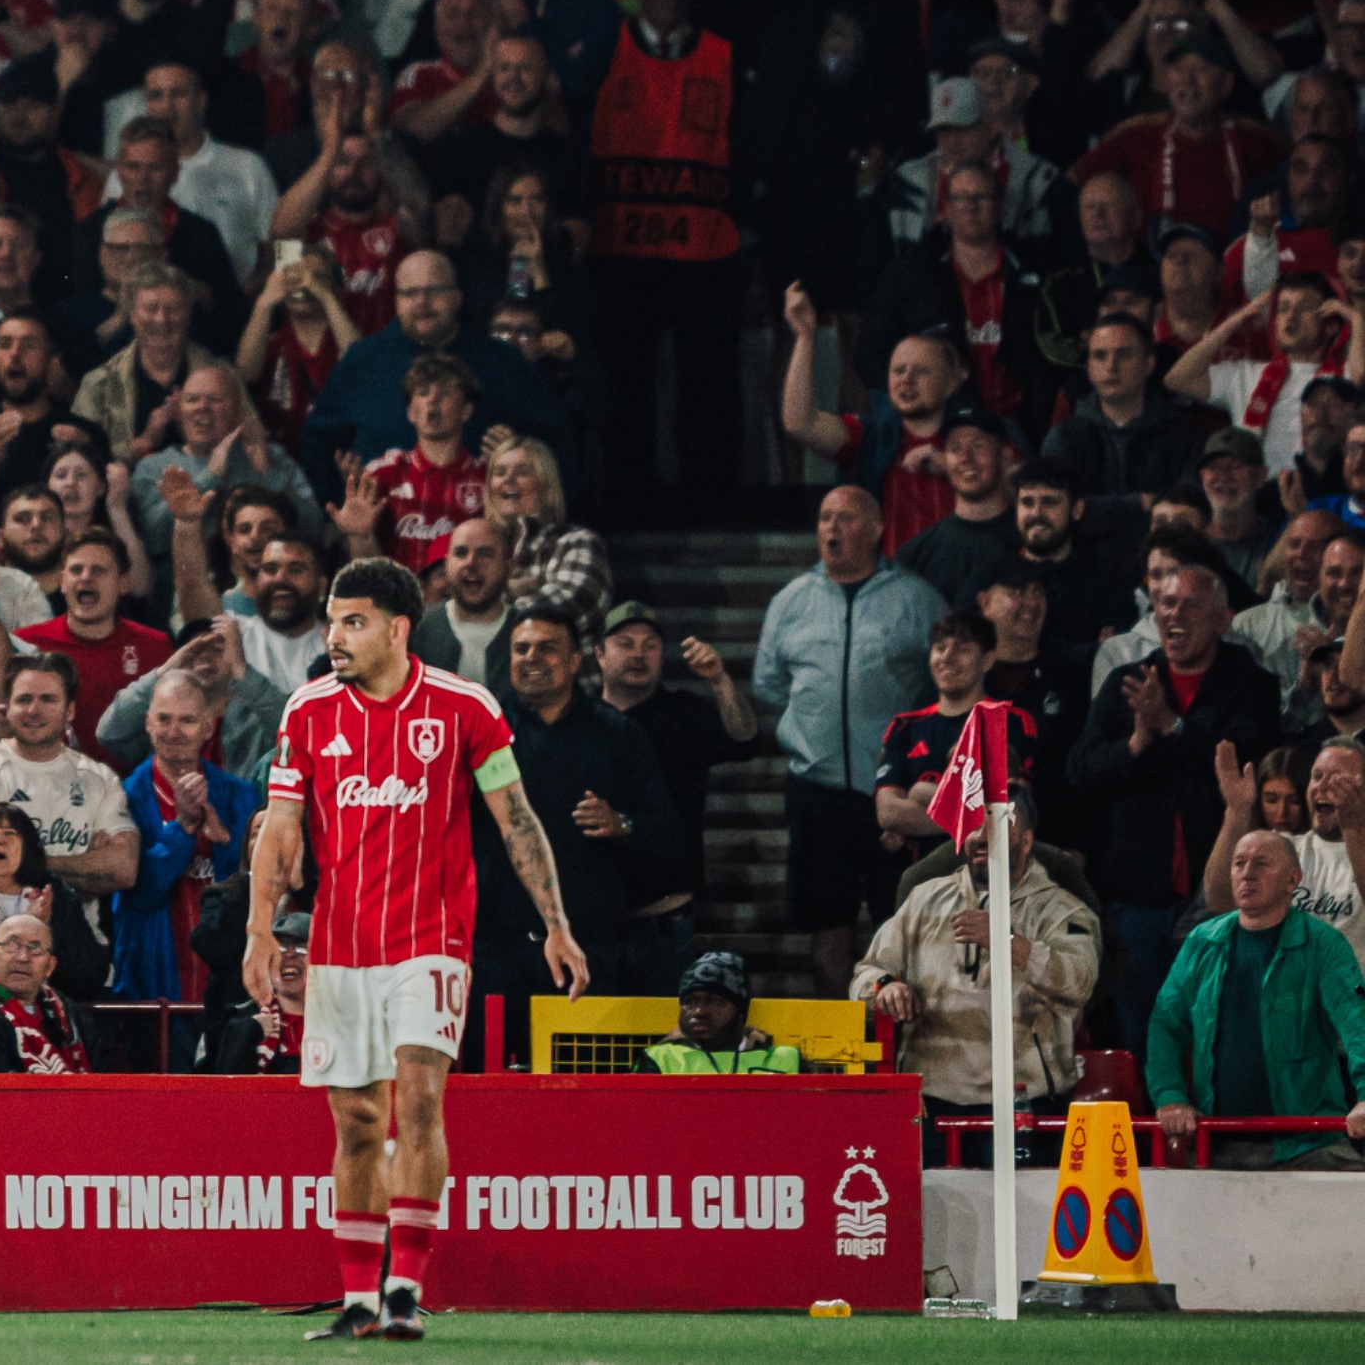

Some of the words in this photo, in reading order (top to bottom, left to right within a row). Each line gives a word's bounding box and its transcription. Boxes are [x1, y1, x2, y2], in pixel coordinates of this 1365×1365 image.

[336, 774, 429, 814] Bally's
[429, 969, 463, 1018] 10
[5, 1174, 282, 1230] NOTTINGHAM
[466, 1175, 681, 1230] FOOTBALL
[691, 1175, 805, 1230] CLUB
